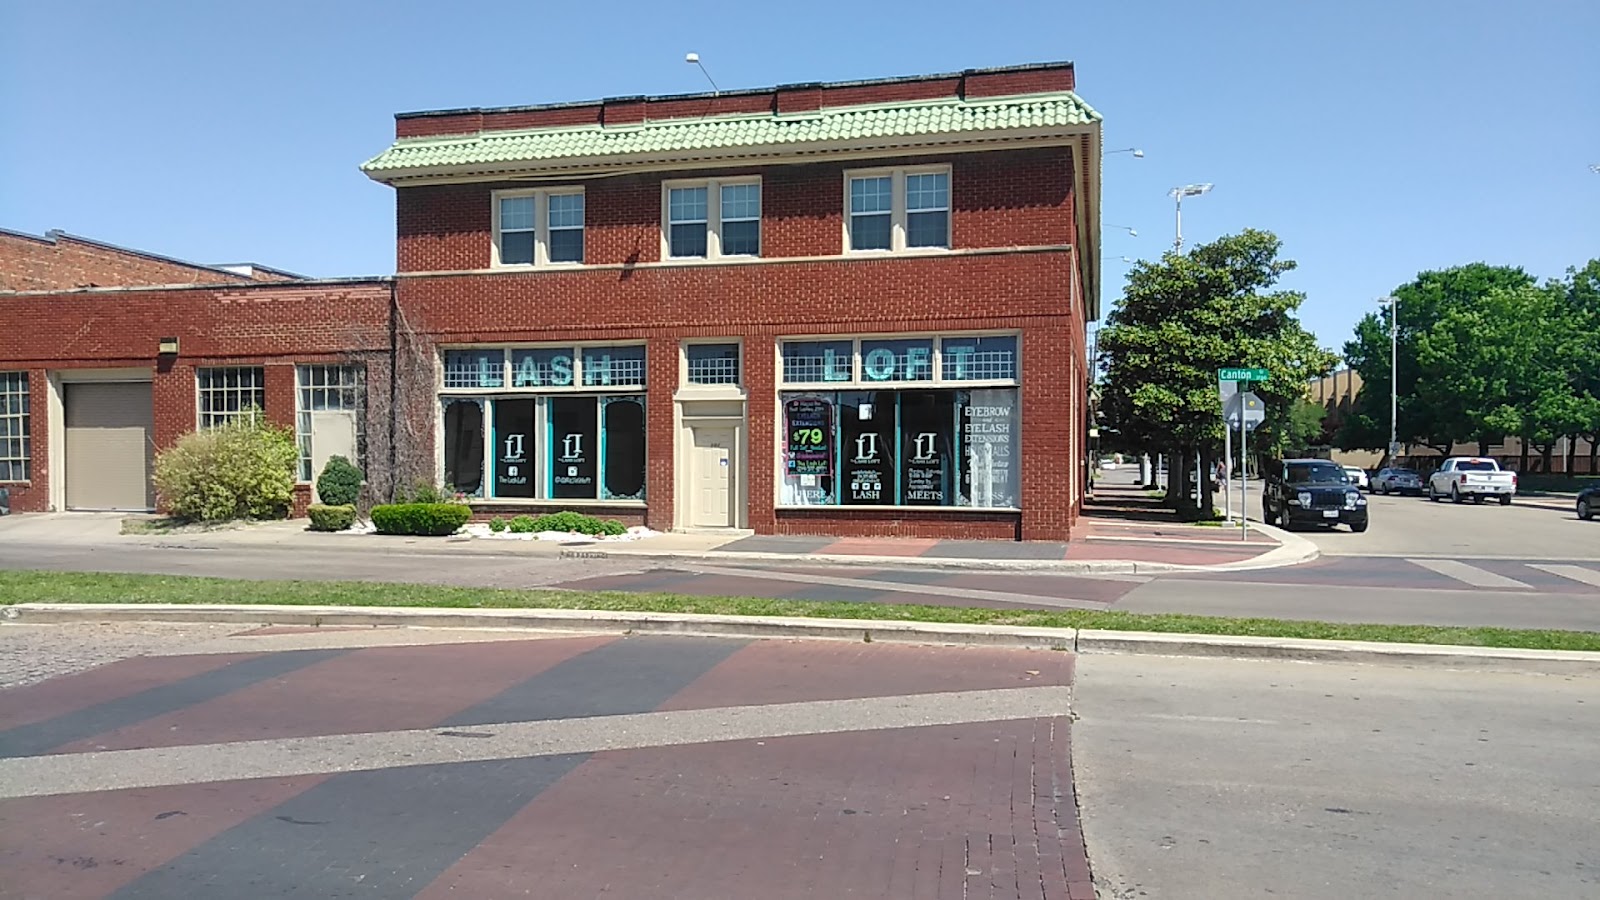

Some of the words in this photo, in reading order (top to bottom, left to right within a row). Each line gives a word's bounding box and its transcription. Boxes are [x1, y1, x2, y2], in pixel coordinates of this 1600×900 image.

[823, 347, 975, 381] LOFT
[479, 355, 612, 387] LASH
[964, 406, 1011, 417] EYEBROW
[964, 423, 1010, 433] EYELASH
[793, 428, 823, 445] $79
[964, 434, 1010, 443] EXTENSIONS
[852, 490, 880, 500] LASH
[907, 490, 944, 500] MEETS
